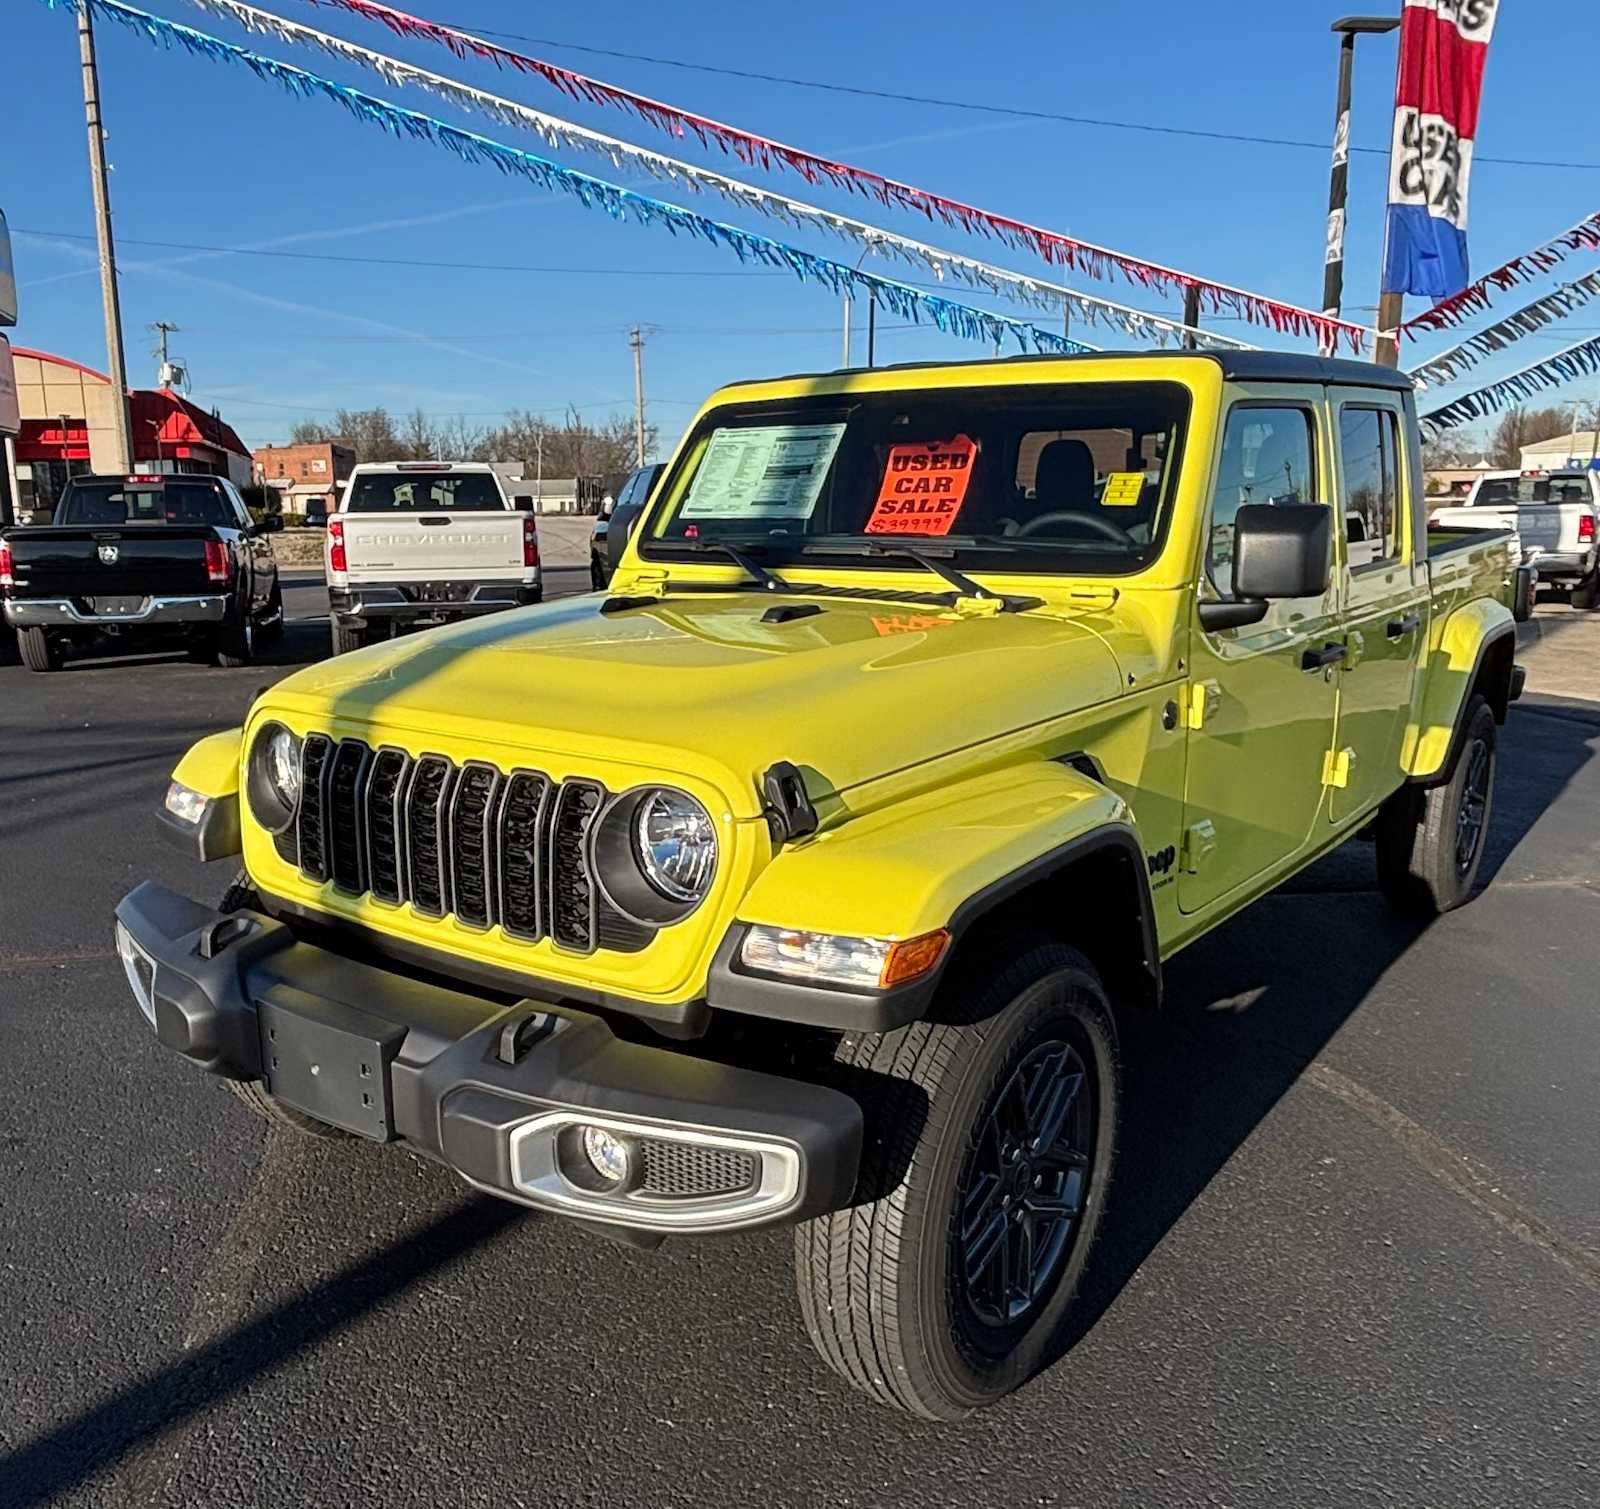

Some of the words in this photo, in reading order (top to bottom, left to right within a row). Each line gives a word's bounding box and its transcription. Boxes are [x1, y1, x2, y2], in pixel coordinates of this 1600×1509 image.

[892, 453, 970, 472] USED
[894, 477, 953, 493] CAR
[878, 498, 957, 515] SALE
[356, 533, 512, 545] CHEVROLET
